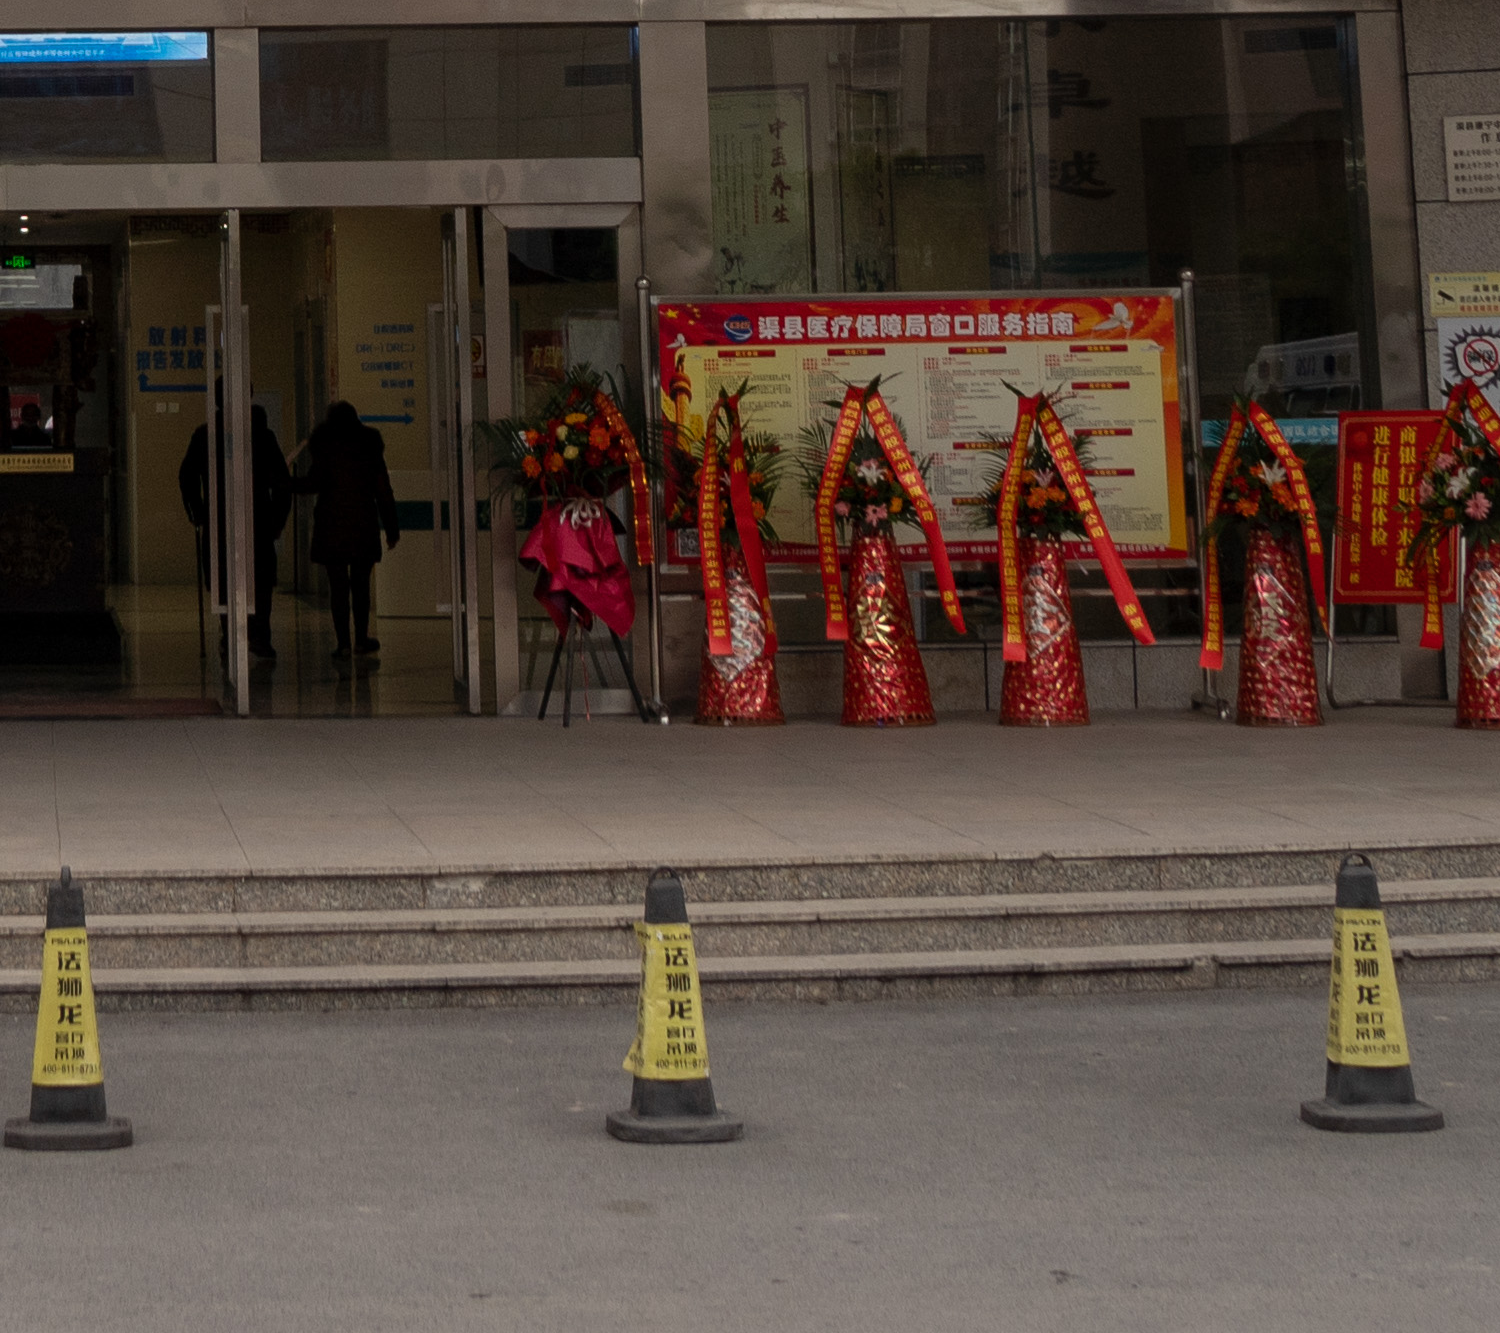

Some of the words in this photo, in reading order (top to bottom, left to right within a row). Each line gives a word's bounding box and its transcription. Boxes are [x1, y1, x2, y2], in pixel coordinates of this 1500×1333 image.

[757, 311, 1074, 340] 渠县医疗保障局窗口服务指南
[1370, 425, 1392, 556] 进行健康体检。
[57, 951, 82, 1025] 法狮龙
[664, 947, 693, 1020] 法狮龙
[1352, 932, 1380, 1006] 法狮龙
